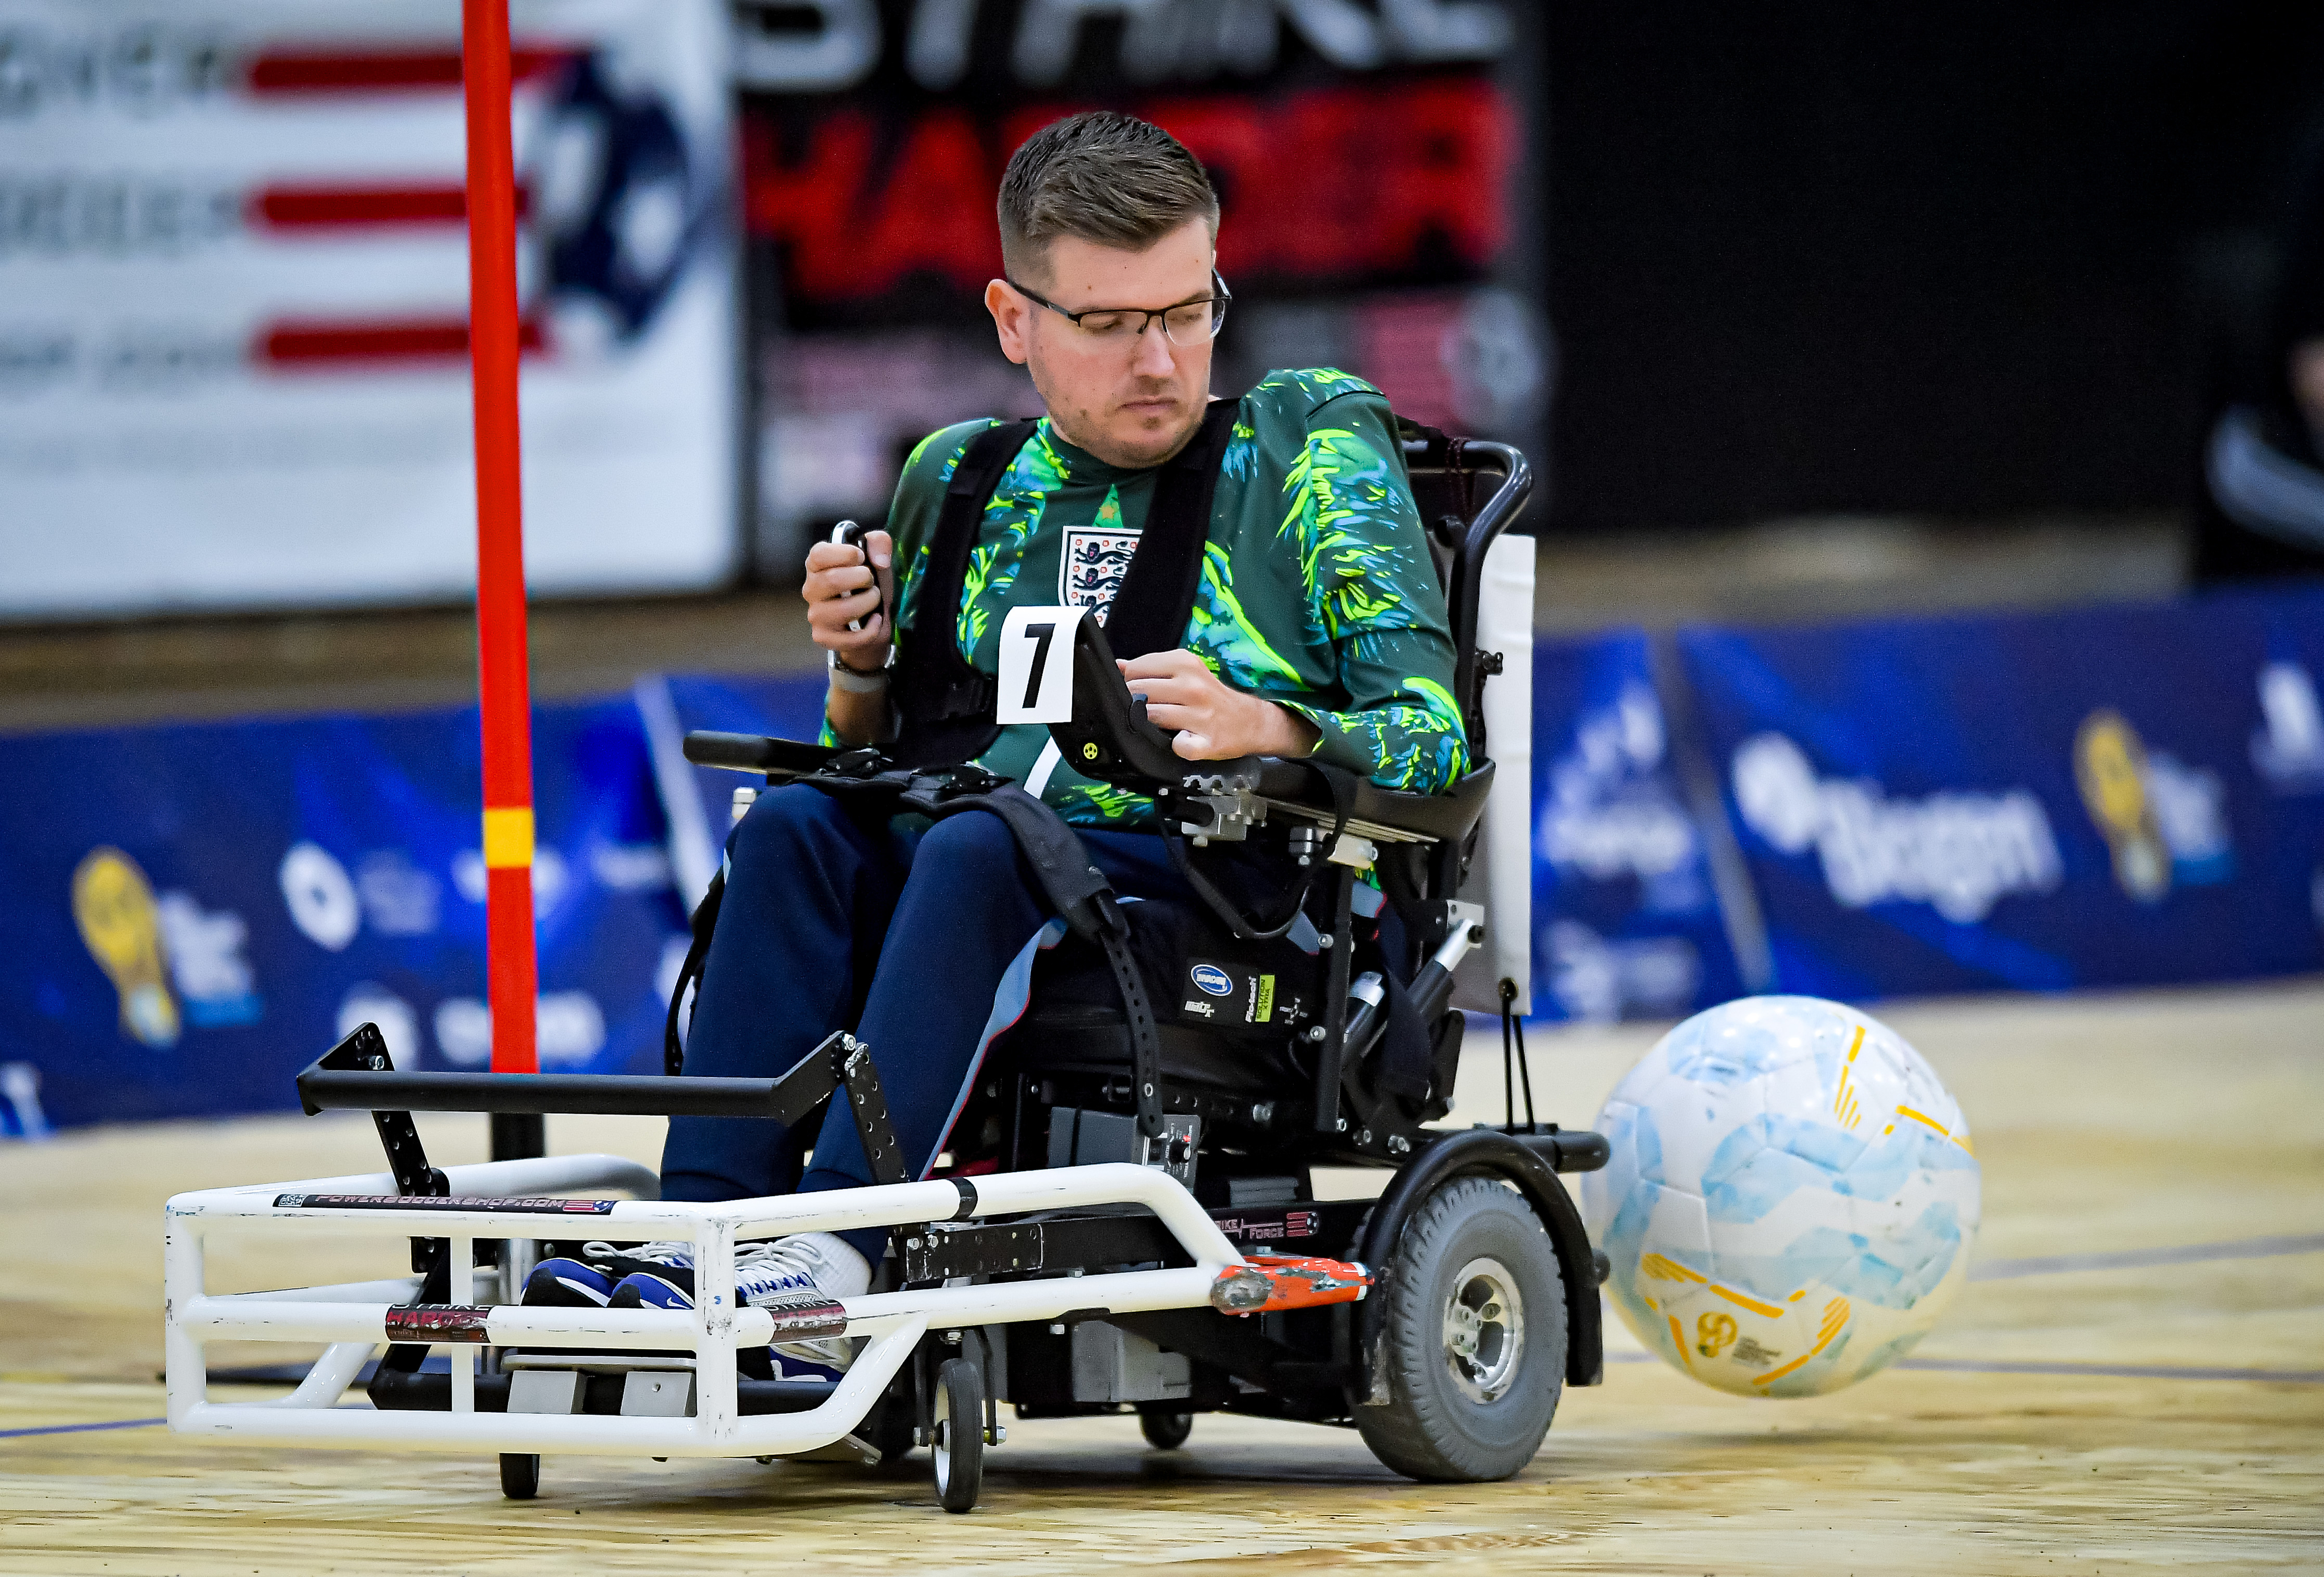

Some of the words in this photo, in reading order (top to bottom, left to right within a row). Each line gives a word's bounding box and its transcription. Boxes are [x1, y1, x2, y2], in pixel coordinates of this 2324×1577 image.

[1022, 623, 1057, 709] 7
[1257, 979, 1266, 1019] SOLUTION
[315, 1194, 566, 1208] POWERSOCCERSHOP.COM
[1249, 1227, 1284, 1239] FORCE
